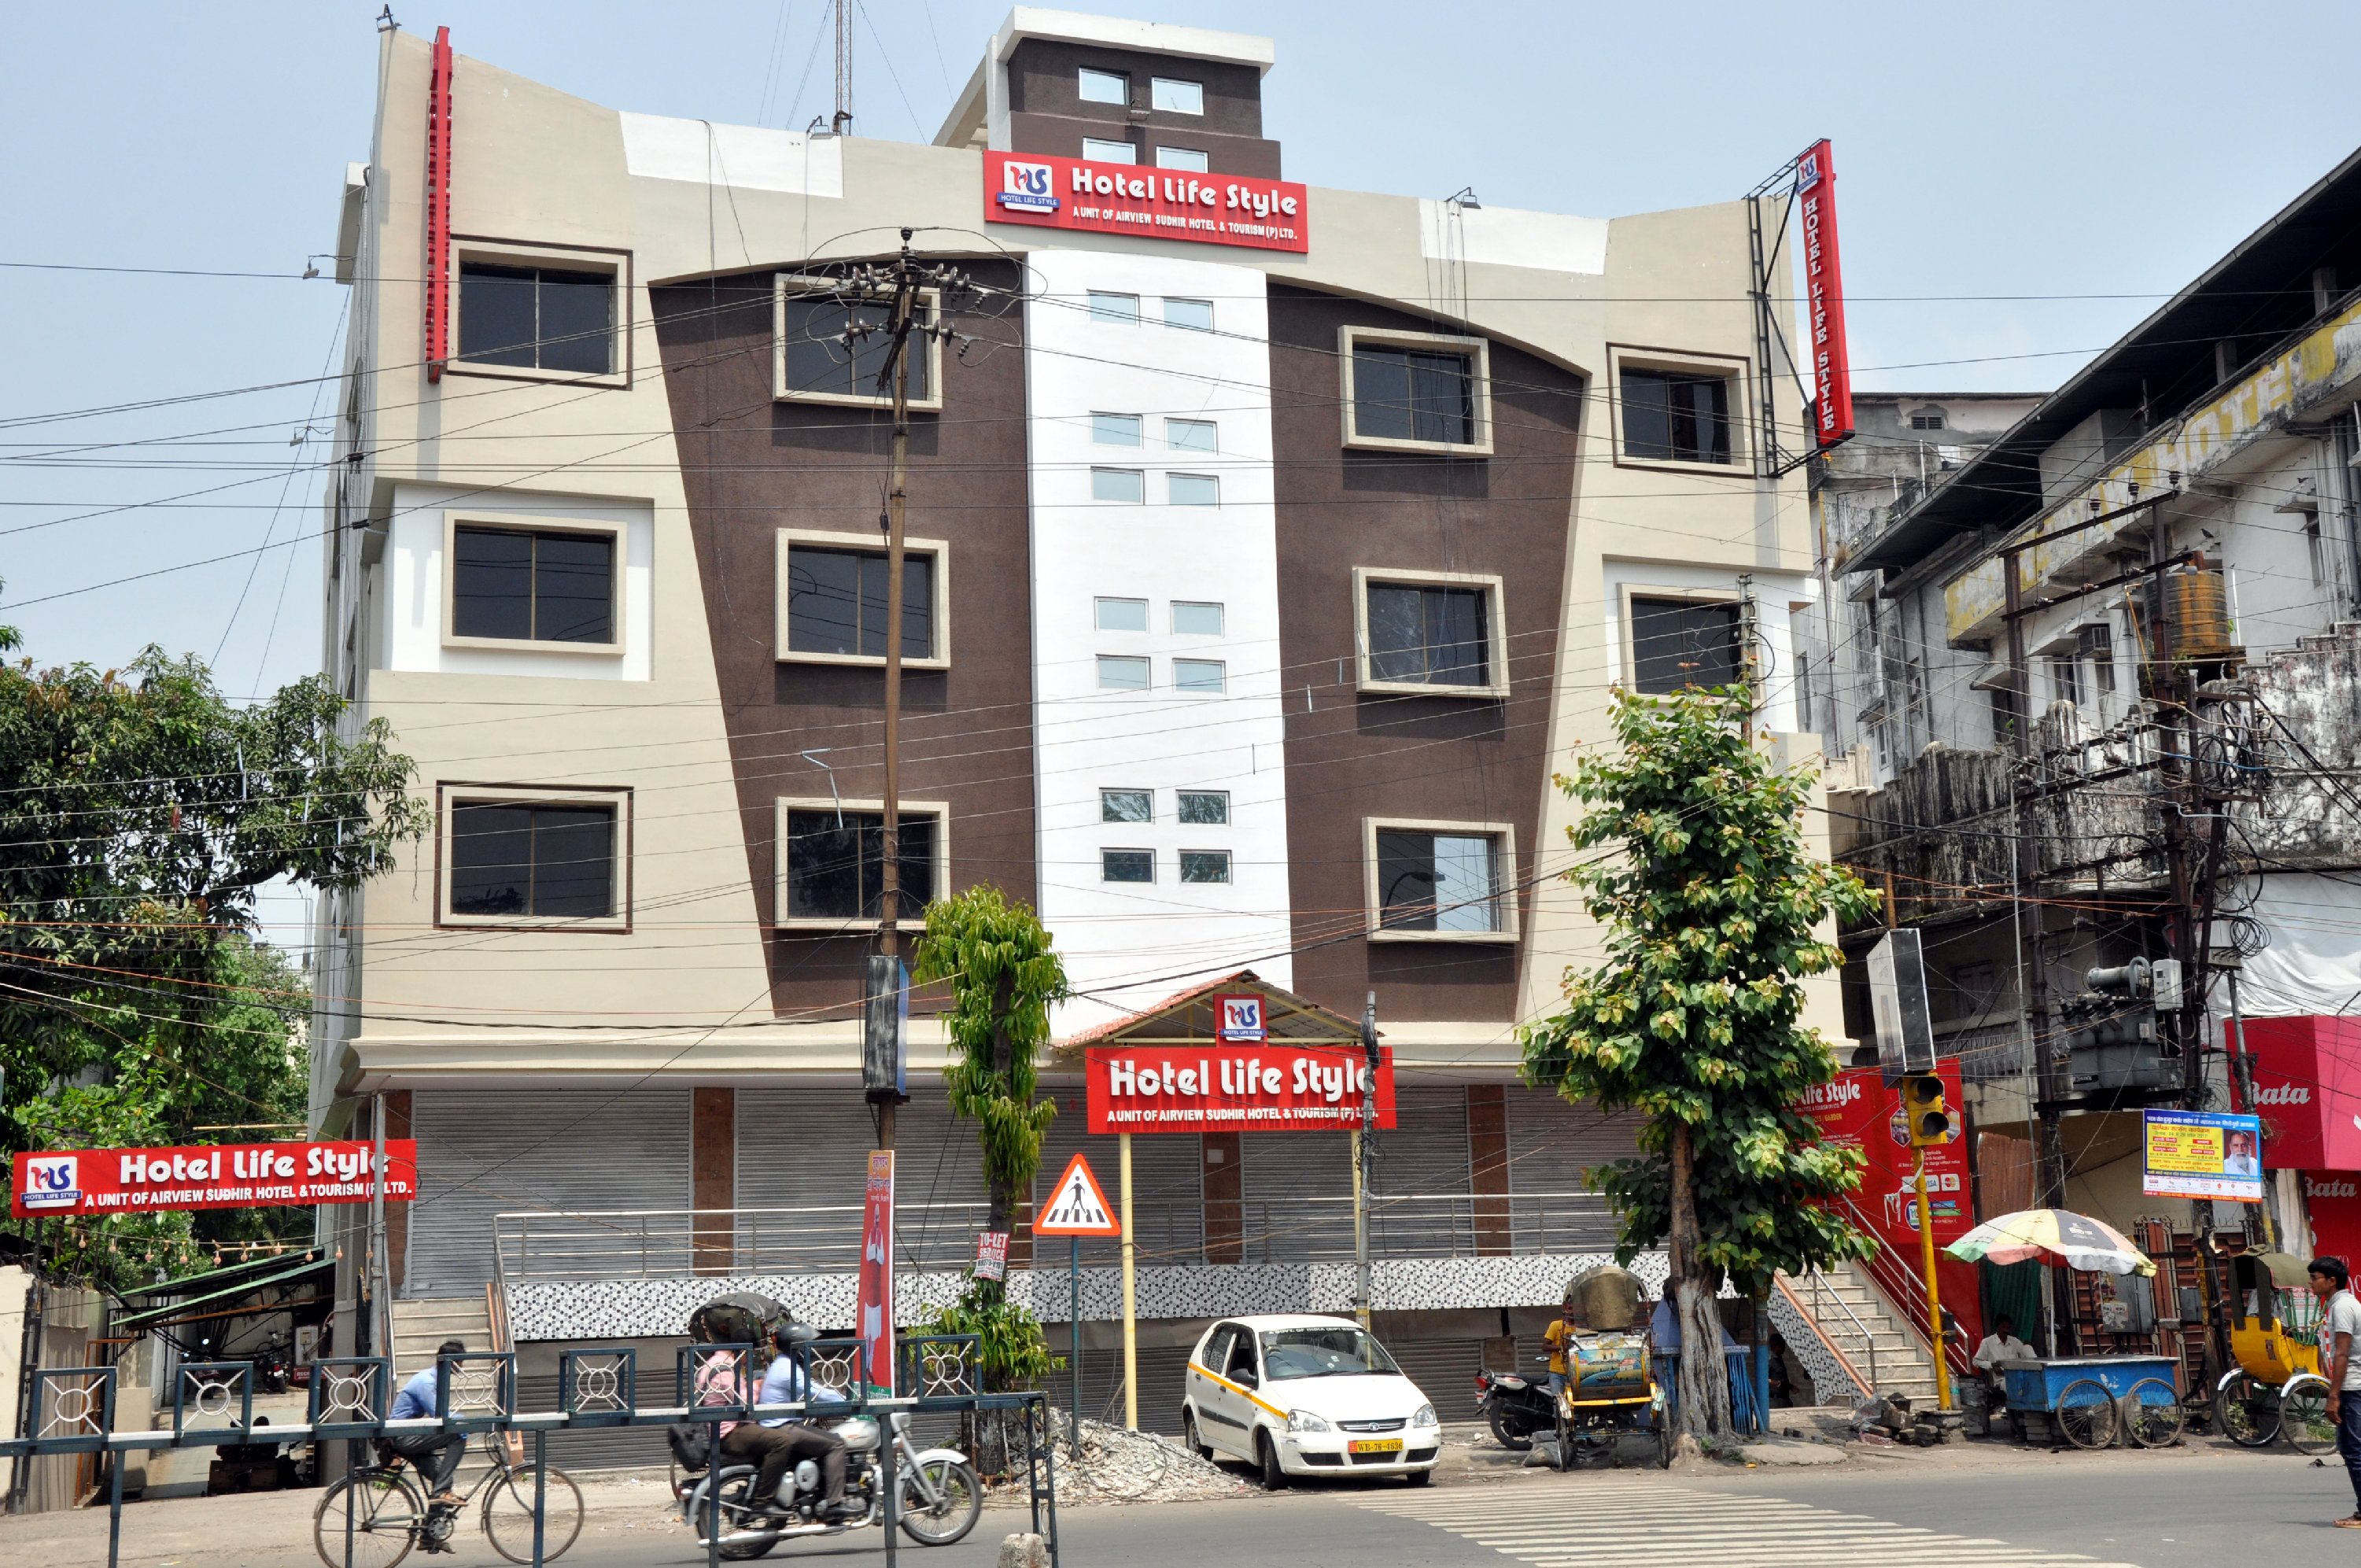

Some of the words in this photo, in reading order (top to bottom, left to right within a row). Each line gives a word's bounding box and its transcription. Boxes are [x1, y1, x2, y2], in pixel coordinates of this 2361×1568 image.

[1001, 194, 1023, 203] HOTEL
[1072, 167, 1155, 199] Hotel
[1164, 177, 1216, 205] Life
[1227, 184, 1297, 218] Style
[1073, 206, 1079, 217] A
[1080, 207, 1100, 219] UNIT
[1102, 208, 1114, 220] OF
[1116, 211, 1152, 223] AIRVIEW
[1156, 214, 1186, 228] SUDHIR
[1189, 218, 1216, 231] HOTEL
[1219, 221, 1226, 231] &
[1228, 222, 1265, 236] TOURISM
[1279, 228, 1297, 239] LTD.
[1804, 197, 1821, 276] HOTEL
[1812, 282, 1828, 345] LIFE
[1817, 351, 1835, 431] STYLE
[1110, 1060, 1209, 1096] Hotel
[1220, 1058, 1282, 1094] Life
[1826, 1079, 1861, 1106] Style
[1107, 1110, 1116, 1121] A
[1116, 1110, 1142, 1121] UNIT
[1143, 1109, 1157, 1121] OF
[1159, 1109, 1204, 1121] AIRVIEW
[1206, 1109, 1245, 1121] SUDHIR
[1248, 1108, 1281, 1120] HOTEL
[1283, 1109, 1291, 1119] &
[1292, 1108, 1338, 1119] TOURISM
[1341, 1107, 1354, 1121] (P)
[120, 1151, 221, 1184] Hotel
[234, 1149, 296, 1179] Life
[85, 1194, 94, 1207] A
[98, 1193, 129, 1206] UNIT
[131, 1192, 149, 1205] OF
[149, 1190, 204, 1205] AIRVIEW
[206, 1187, 252, 1202] SUDHIR
[256, 1185, 296, 1199] HOTEL
[299, 1184, 308, 1197] &
[309, 1182, 363, 1197] TOURISM
[384, 1181, 412, 1194] LTD.
[979, 1232, 1009, 1249] TO-LET
[979, 1247, 1005, 1260] SERVICE
